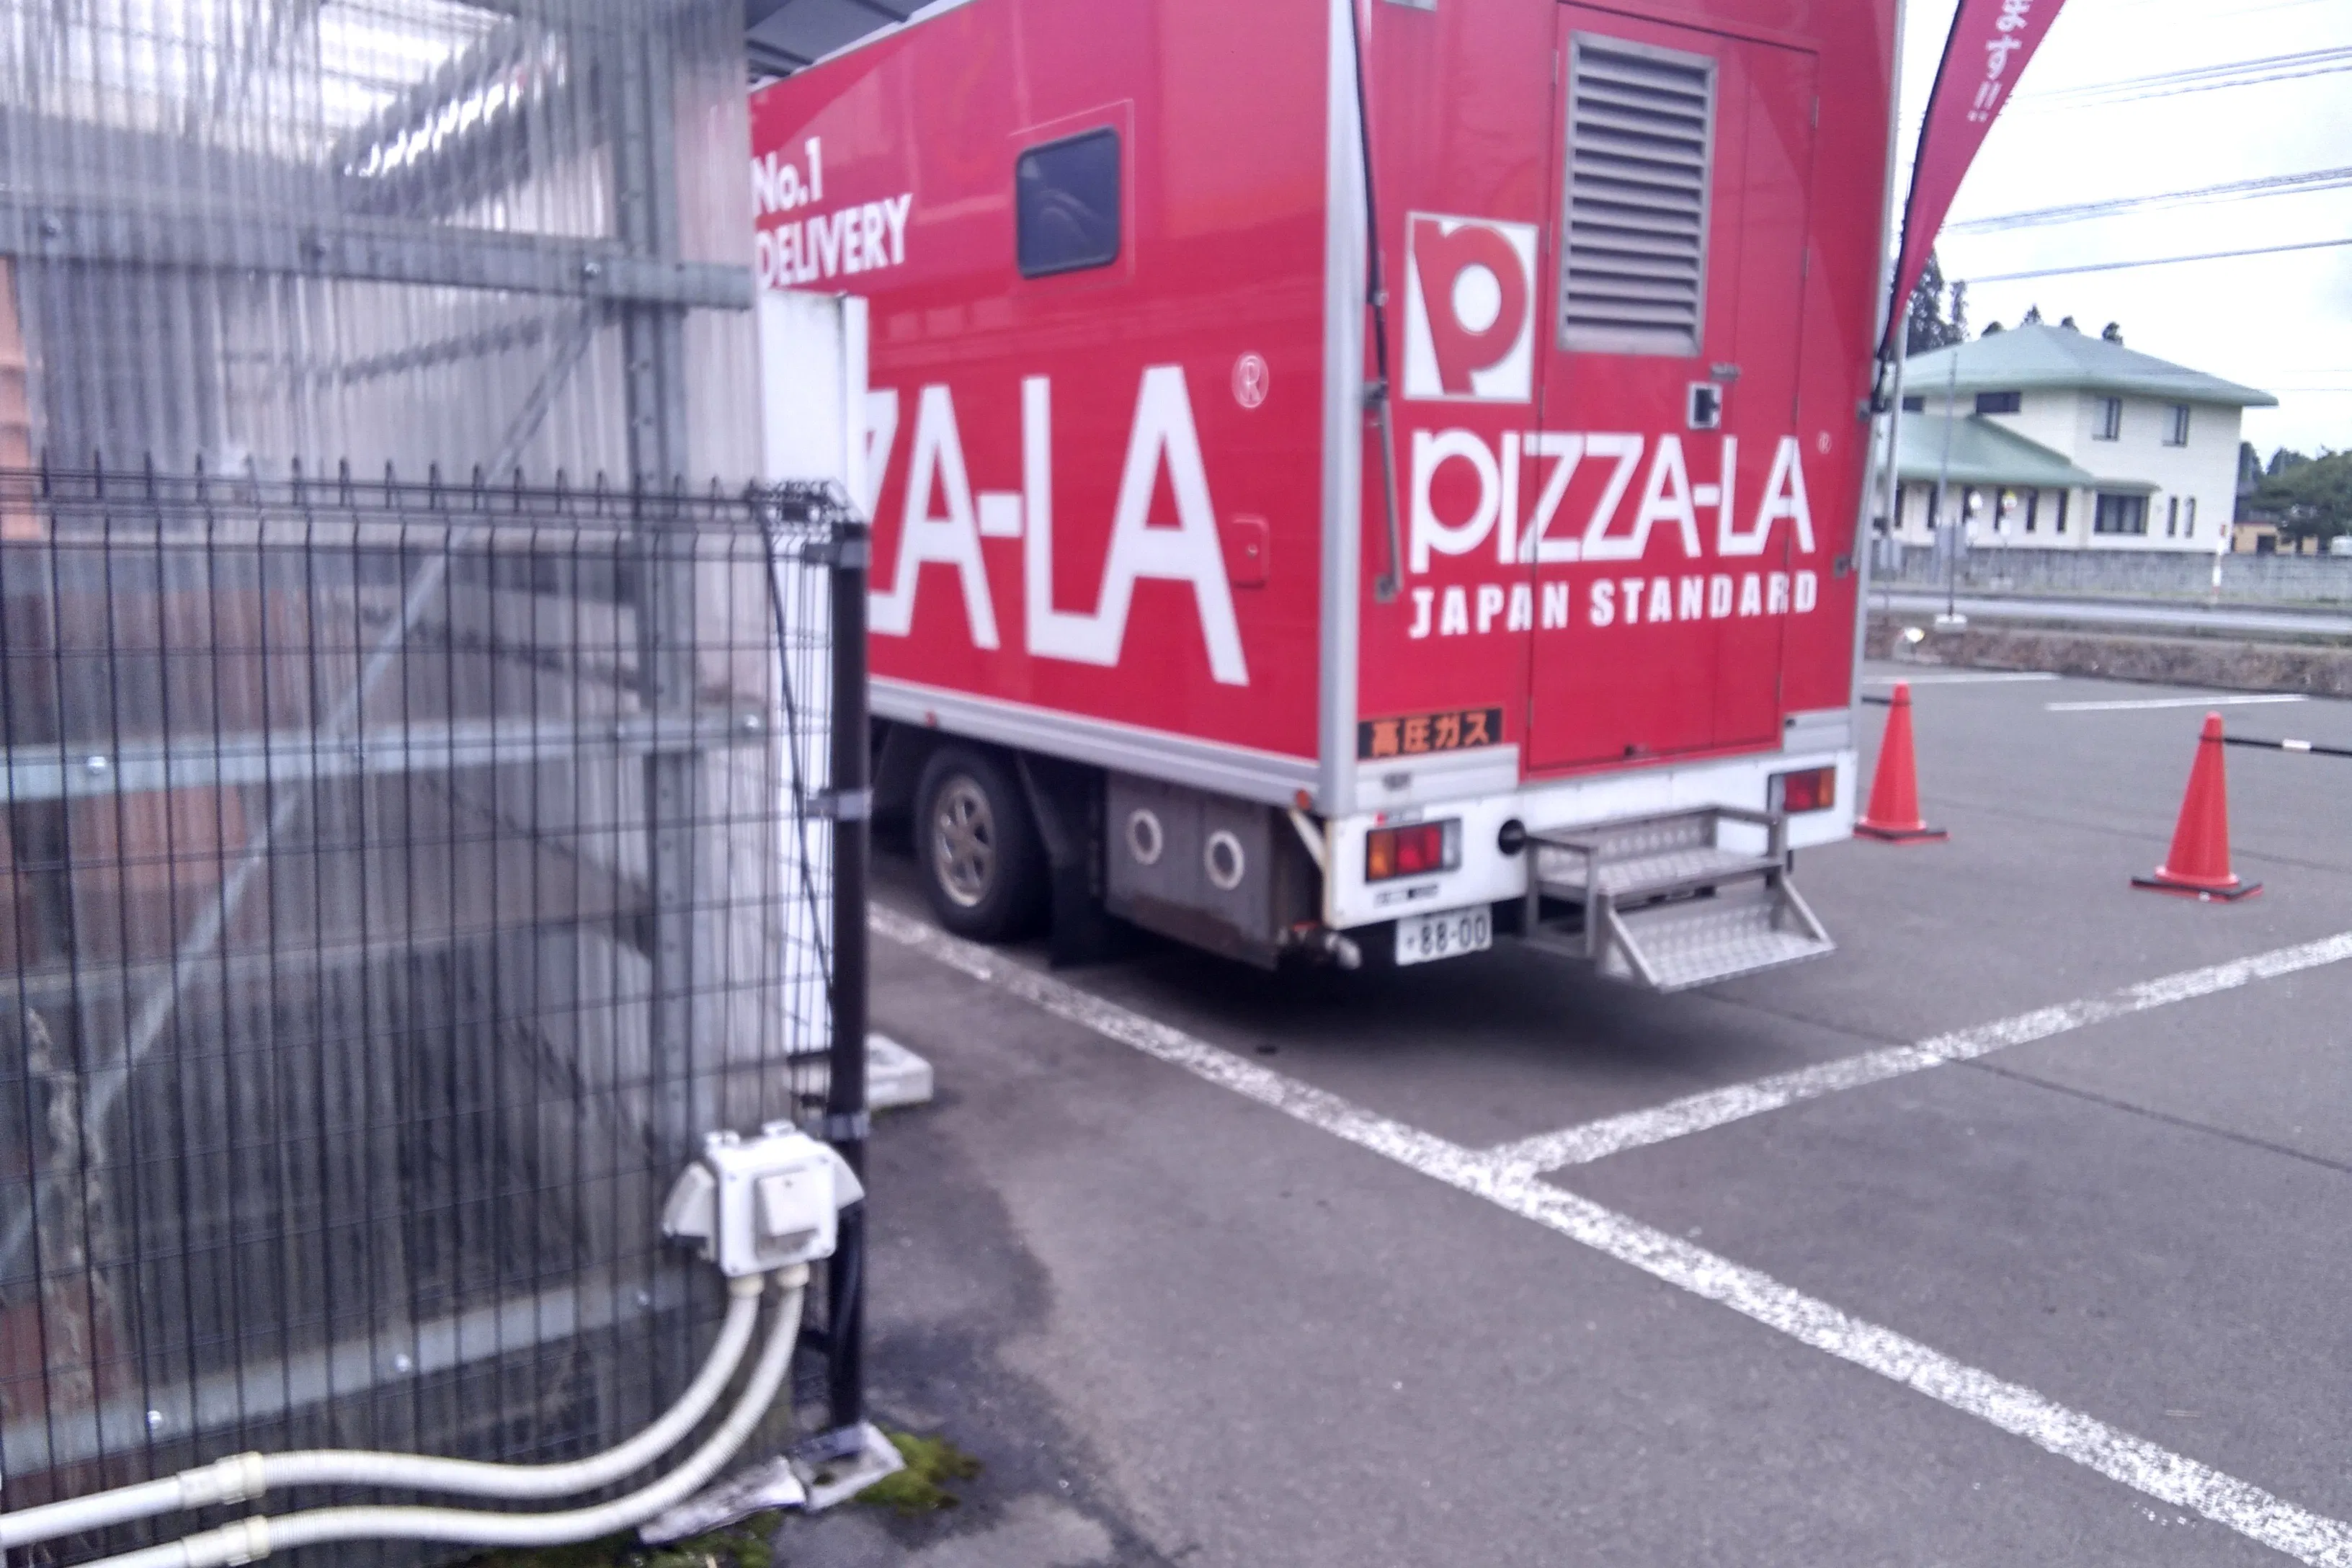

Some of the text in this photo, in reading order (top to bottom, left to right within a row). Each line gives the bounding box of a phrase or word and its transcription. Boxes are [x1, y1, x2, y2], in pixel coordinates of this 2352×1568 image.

[751, 135, 823, 217] No.1
[756, 192, 913, 288] DELIVERY
[1408, 570, 1818, 639] JAPAN STANDARD
[1372, 710, 1489, 758] 高圧ガス
